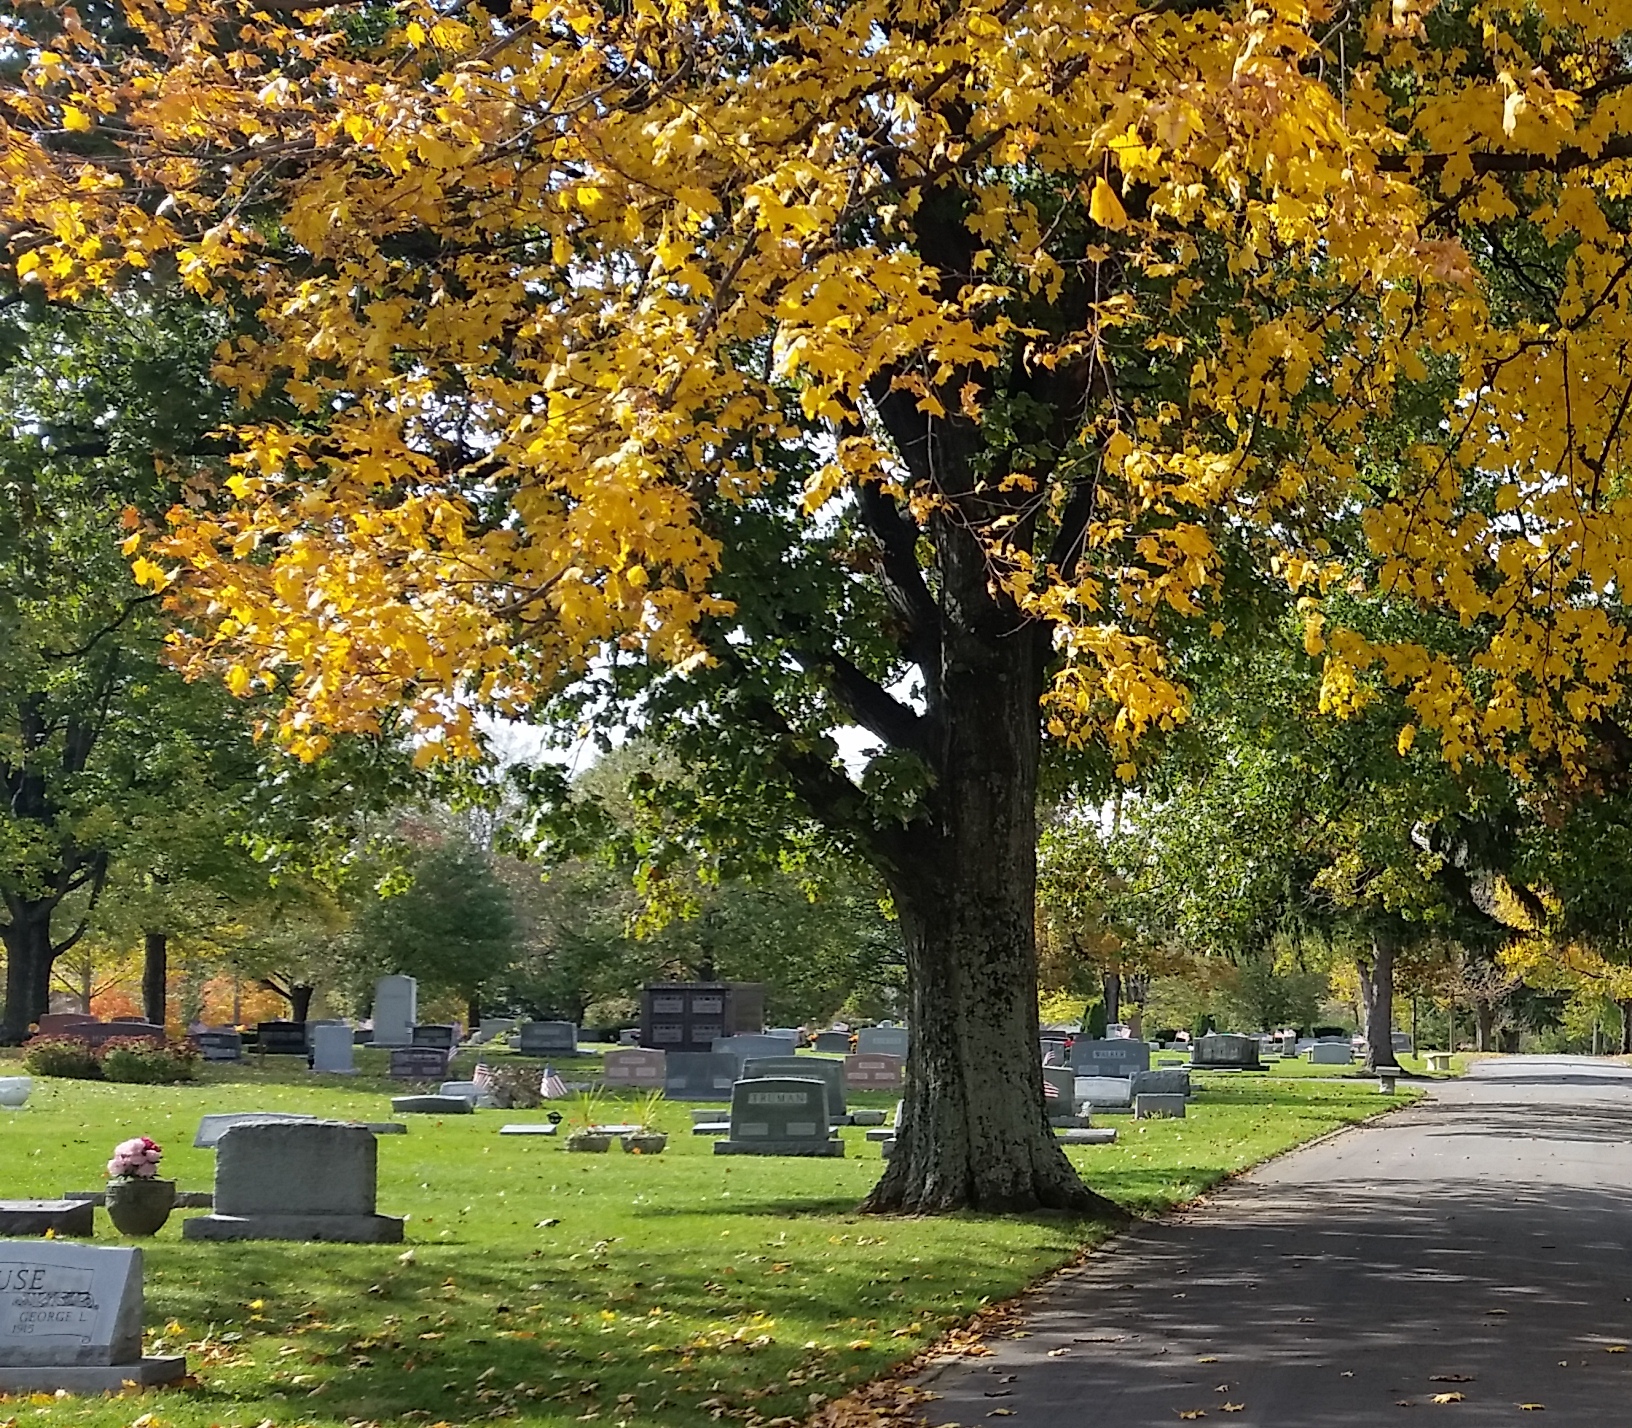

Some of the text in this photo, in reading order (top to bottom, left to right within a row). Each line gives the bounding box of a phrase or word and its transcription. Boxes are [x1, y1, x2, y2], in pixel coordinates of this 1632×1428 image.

[749, 1093, 806, 1103] TRUMAN
[20, 1311, 87, 1322] GEORGE L
